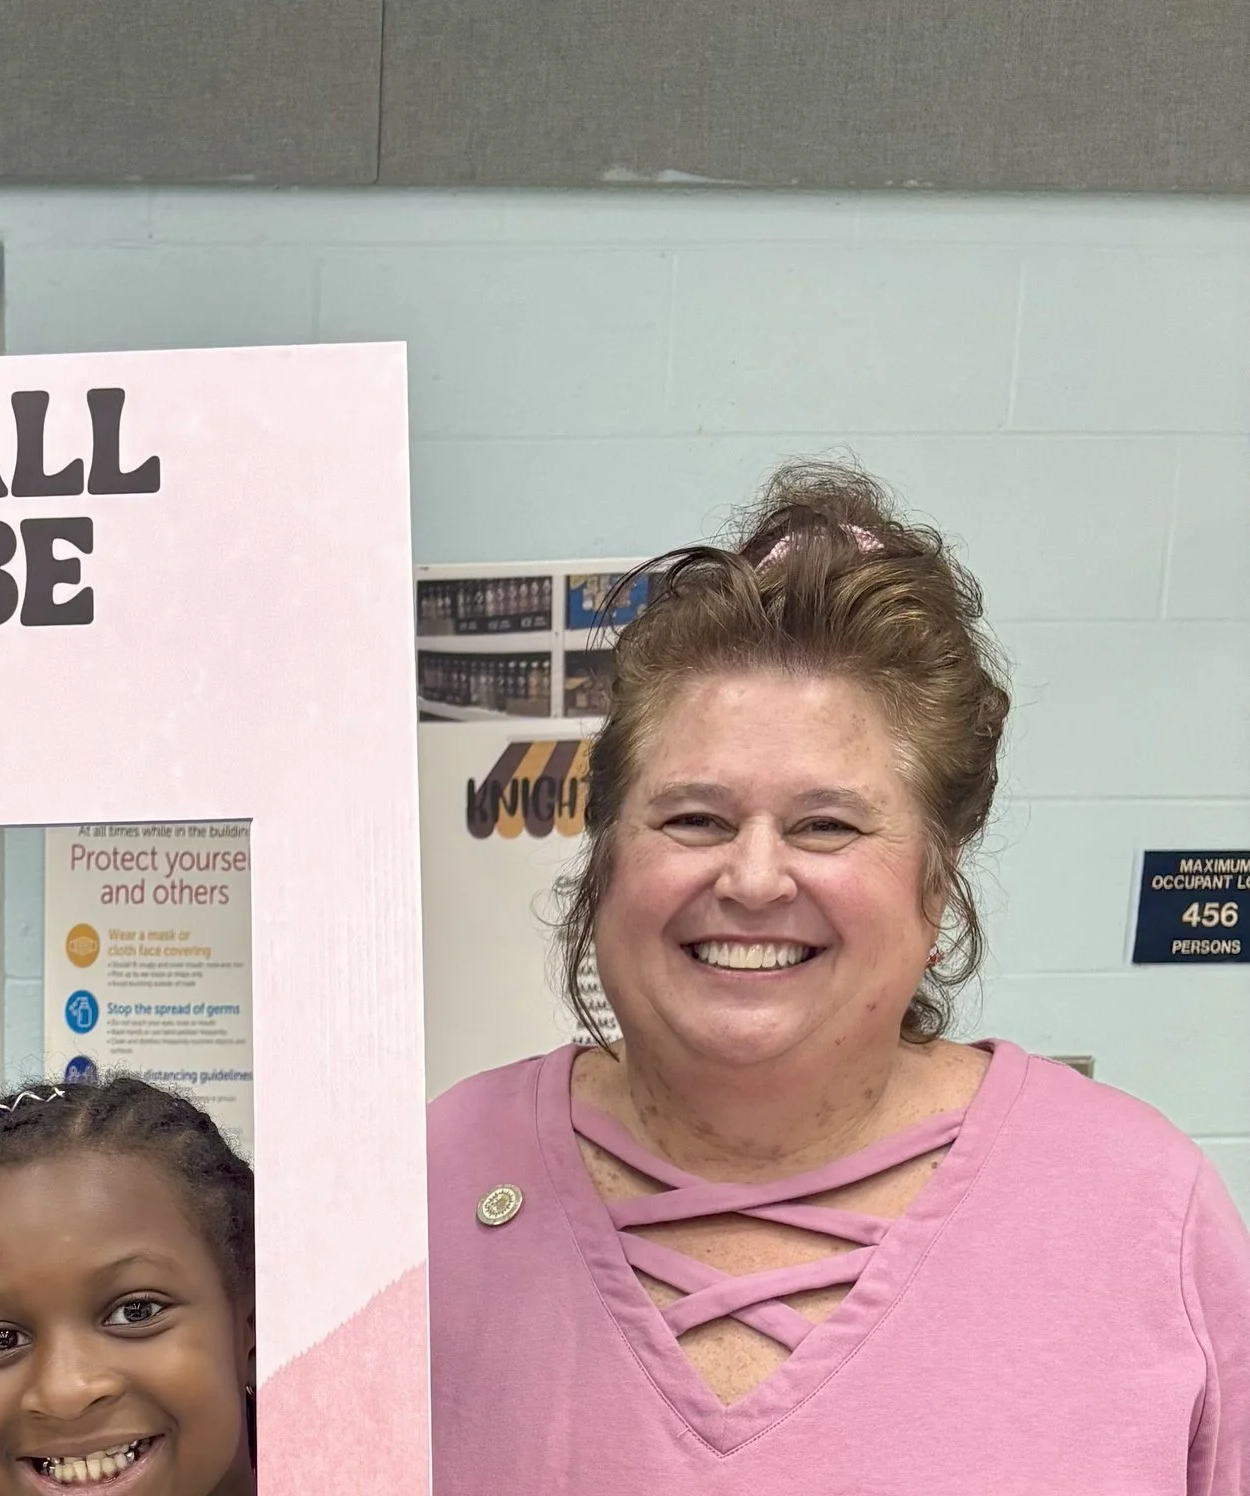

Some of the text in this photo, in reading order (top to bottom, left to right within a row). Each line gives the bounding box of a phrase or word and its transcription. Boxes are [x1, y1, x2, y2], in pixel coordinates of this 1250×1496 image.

[467, 776, 586, 822] KNIGH
[93, 826, 106, 838] all
[109, 826, 139, 838] times
[143, 826, 173, 838] while
[175, 827, 186, 838] in
[188, 826, 206, 838] the
[209, 825, 249, 838] buildin
[70, 843, 251, 878] Protect yoursel
[1179, 858, 1250, 873] MAXIMUM
[1151, 874, 1234, 890] OCCUPANT
[100, 878, 230, 905] and others
[1182, 901, 1239, 928] 456
[108, 930, 136, 941] Wear
[148, 929, 174, 941] mask
[108, 945, 212, 959] cloth face covering
[1171, 939, 1241, 955] PERSONS
[107, 1002, 240, 1018] Stop the spread of germs
